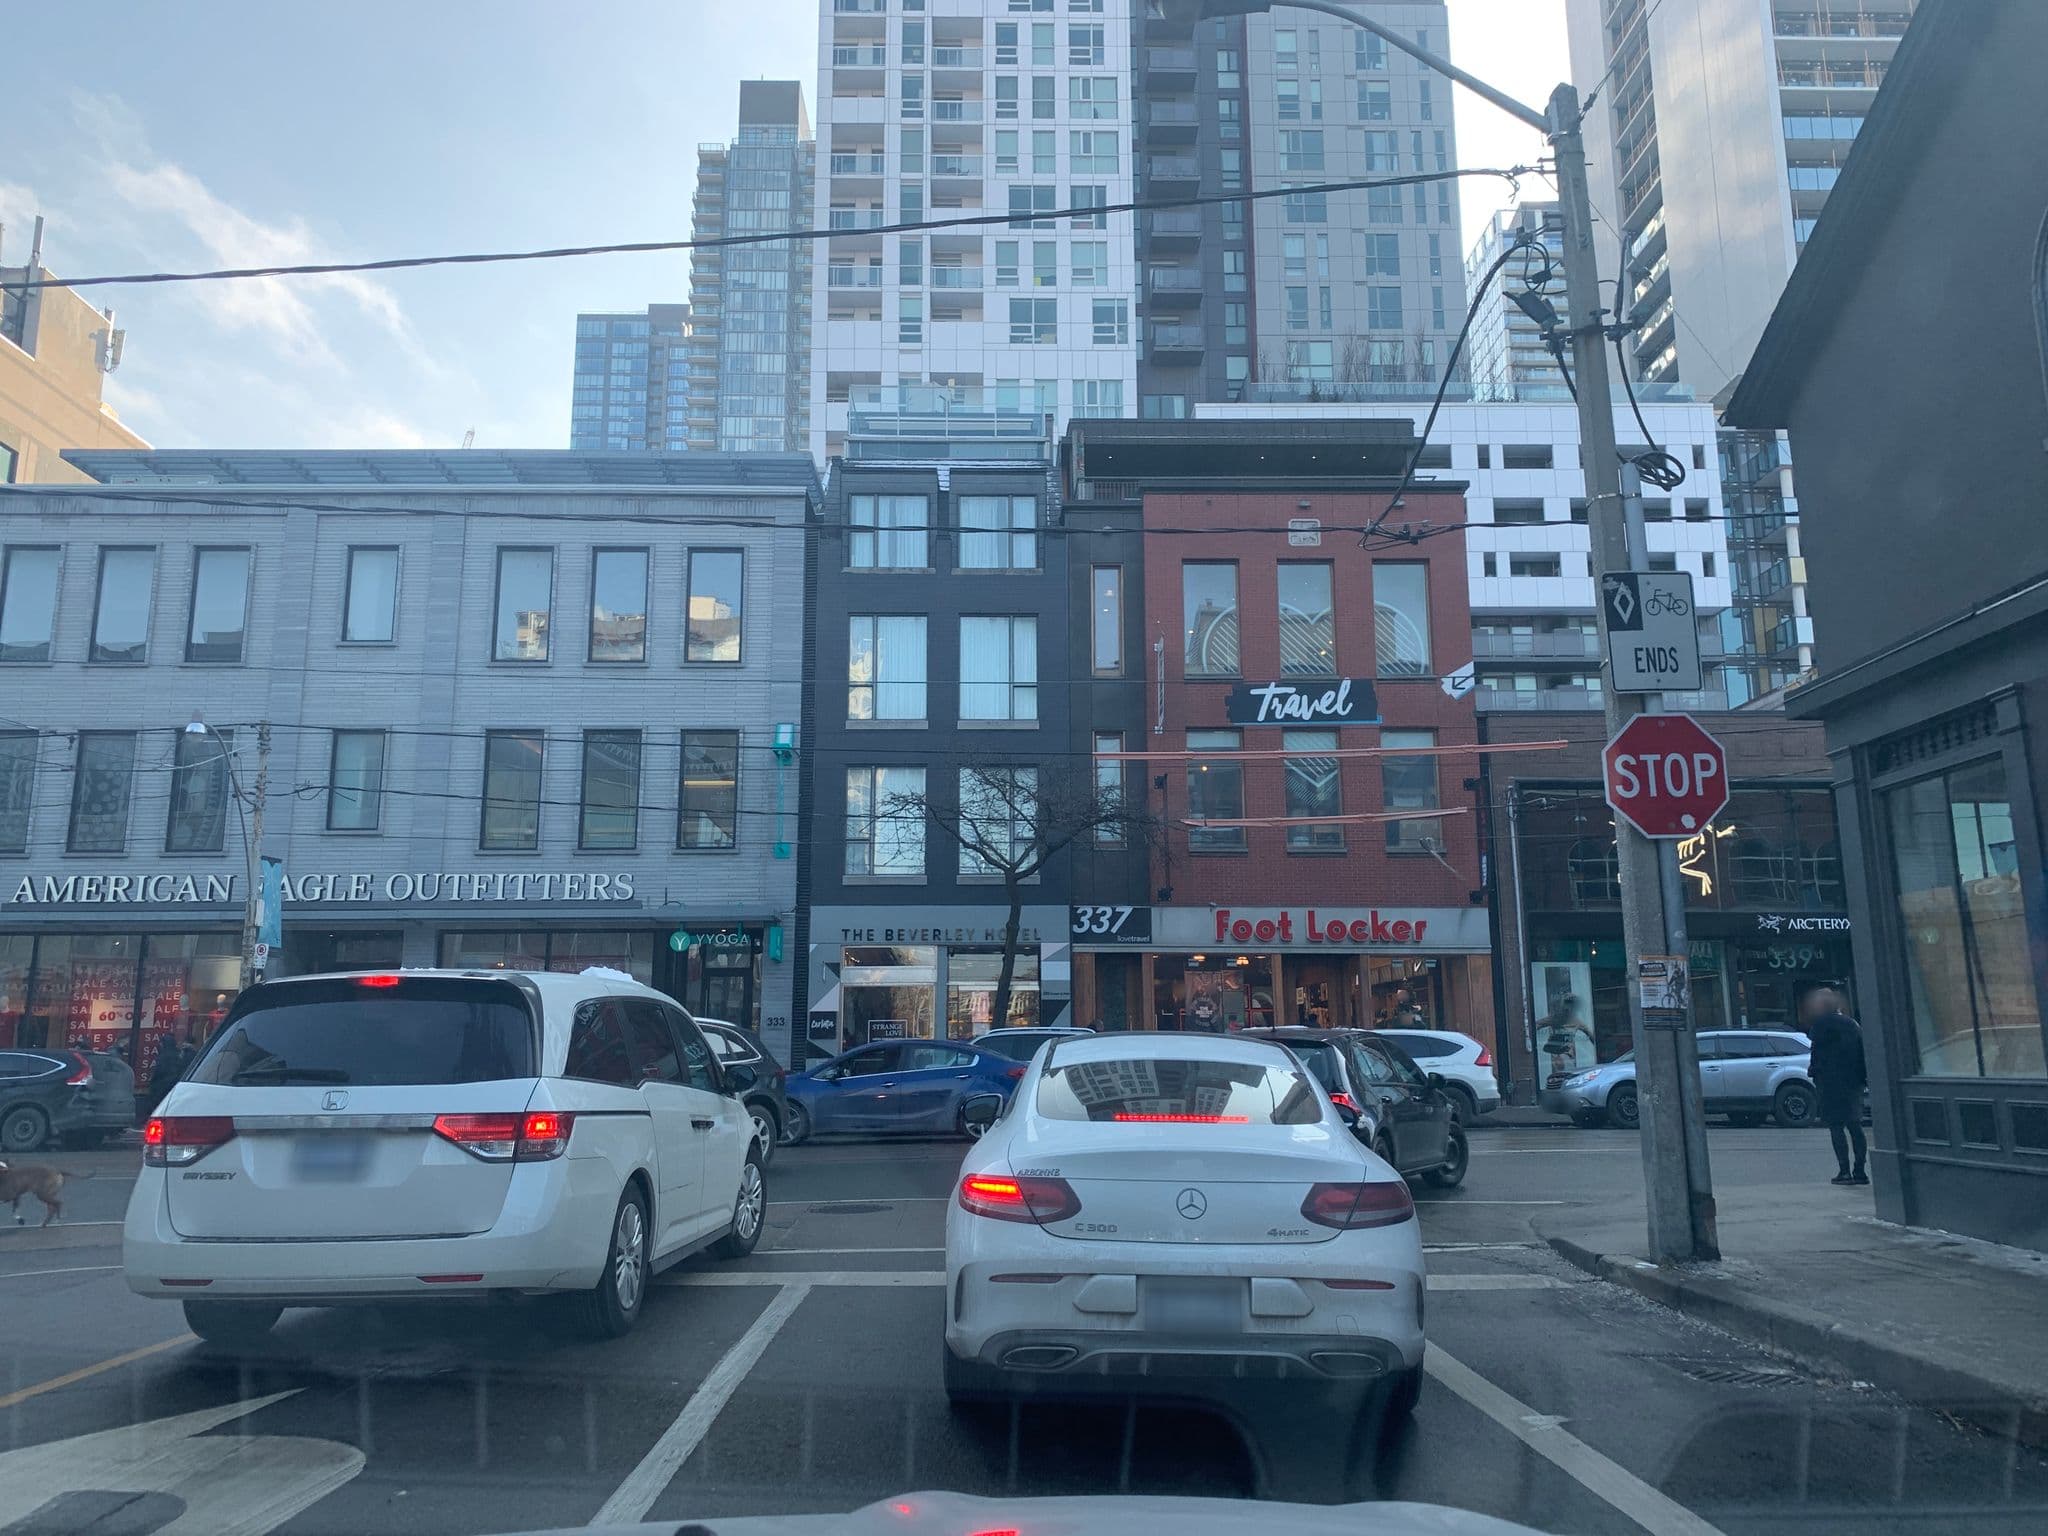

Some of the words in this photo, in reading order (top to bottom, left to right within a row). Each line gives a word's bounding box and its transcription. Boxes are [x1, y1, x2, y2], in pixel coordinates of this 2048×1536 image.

[1633, 647, 1679, 673] ENDS
[1250, 677, 1353, 722] Travel
[1614, 752, 1717, 798] STOP
[10, 874, 236, 903] AMERICAN
[258, 872, 374, 902] AGLE
[385, 873, 635, 902] OUTFITTERS
[1072, 906, 1133, 934] 337
[1215, 909, 1293, 942] Foot
[1305, 908, 1428, 942] Locker
[696, 933, 750, 945] YYOGA
[841, 928, 875, 941] THE
[885, 928, 976, 941] BEVERLEY
[985, 927, 1041, 941] HOEL
[1768, 947, 1814, 969] 339
[74, 980, 106, 989] SALE
[112, 980, 136, 988] SAL
[73, 992, 105, 1001] SALE
[111, 992, 134, 1000] SAL
[71, 1005, 88, 1014] SA
[70, 1021, 86, 1030] SA
[767, 1017, 785, 1026] 333
[183, 1172, 236, 1180] ODYSSEY
[1074, 1223, 1084, 1231] C
[1087, 1223, 1118, 1233] 300
[1267, 1227, 1310, 1238] 4MATIC
